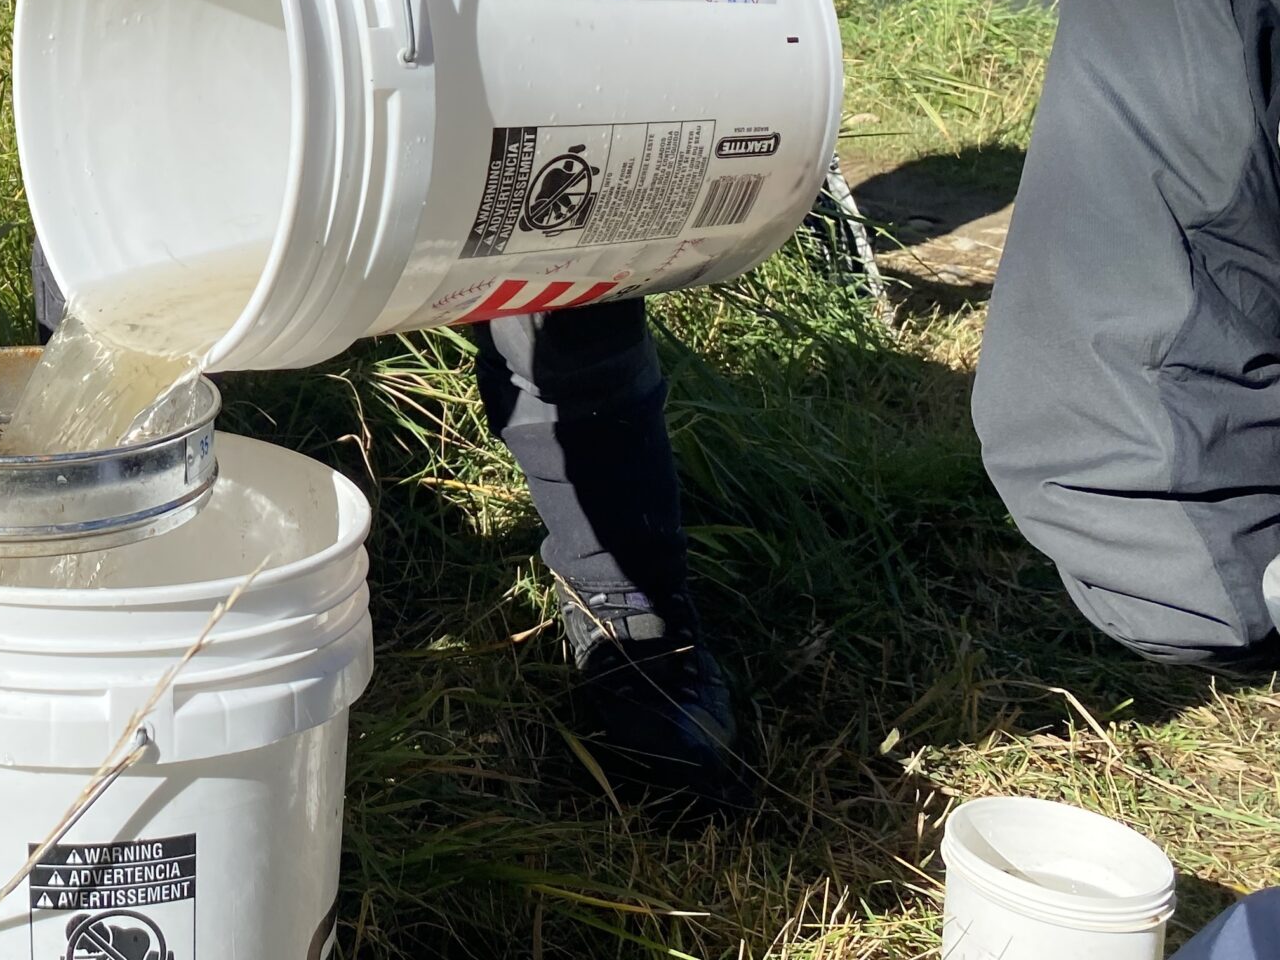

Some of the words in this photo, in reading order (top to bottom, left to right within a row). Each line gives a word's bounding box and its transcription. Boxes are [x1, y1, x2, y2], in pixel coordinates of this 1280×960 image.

[656, 138, 666, 170] ALEJADOS
[663, 131, 672, 166] CONTENGA
[722, 138, 775, 155] LEAKTITE
[619, 163, 627, 180] FROM
[619, 187, 627, 201] EVEN
[626, 157, 634, 178] SMALL
[674, 152, 684, 178] PEUVENT
[478, 160, 502, 223] WARNING
[489, 143, 519, 232] ADVERTENCIA
[500, 132, 536, 238] AVERTISSEMENT
[658, 172, 670, 200] CANTIDAD
[84, 842, 163, 864] WARNING
[69, 862, 181, 886] ADVERTENCIA
[57, 881, 190, 908] AVERTISSEMENT
